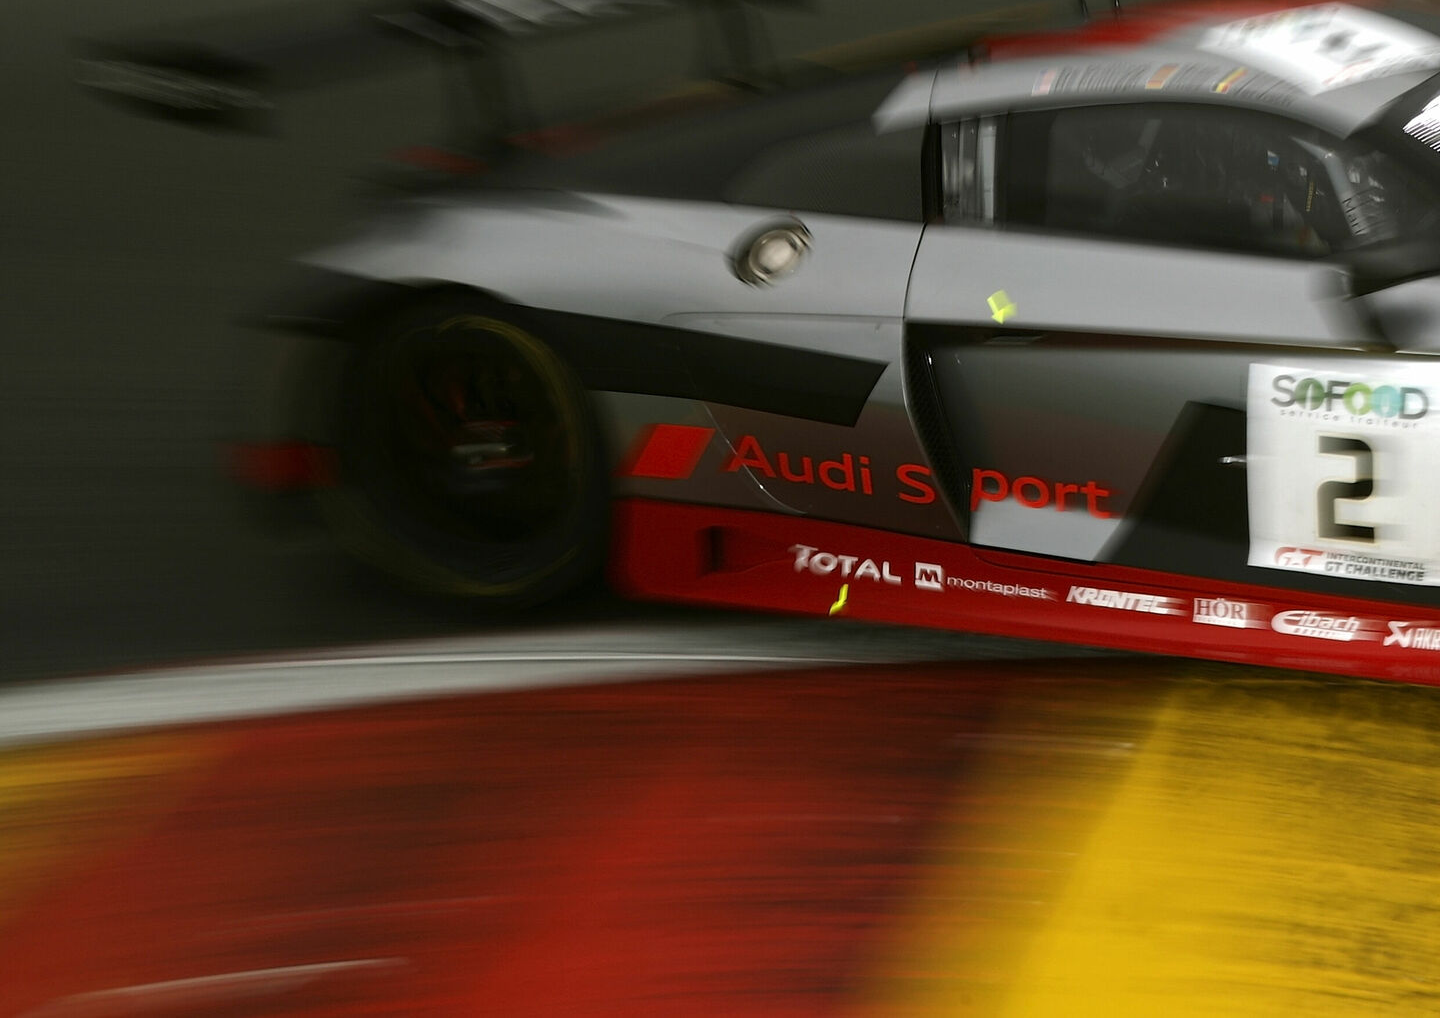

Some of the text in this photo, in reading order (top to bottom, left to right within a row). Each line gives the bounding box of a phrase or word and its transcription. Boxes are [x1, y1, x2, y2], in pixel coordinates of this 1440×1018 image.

[722, 434, 872, 496] Audi
[1317, 435, 1374, 544] 2
[790, 543, 901, 582] TOTAL
[1324, 561, 1425, 582] GT CHALLENGE
[1326, 552, 1425, 570] INTERCONTINENTAL
[946, 576, 1055, 600] montaplast
[1066, 586, 1170, 615] KRONTEC
[1196, 598, 1244, 621] HÖR
[1271, 610, 1358, 636] Eibach
